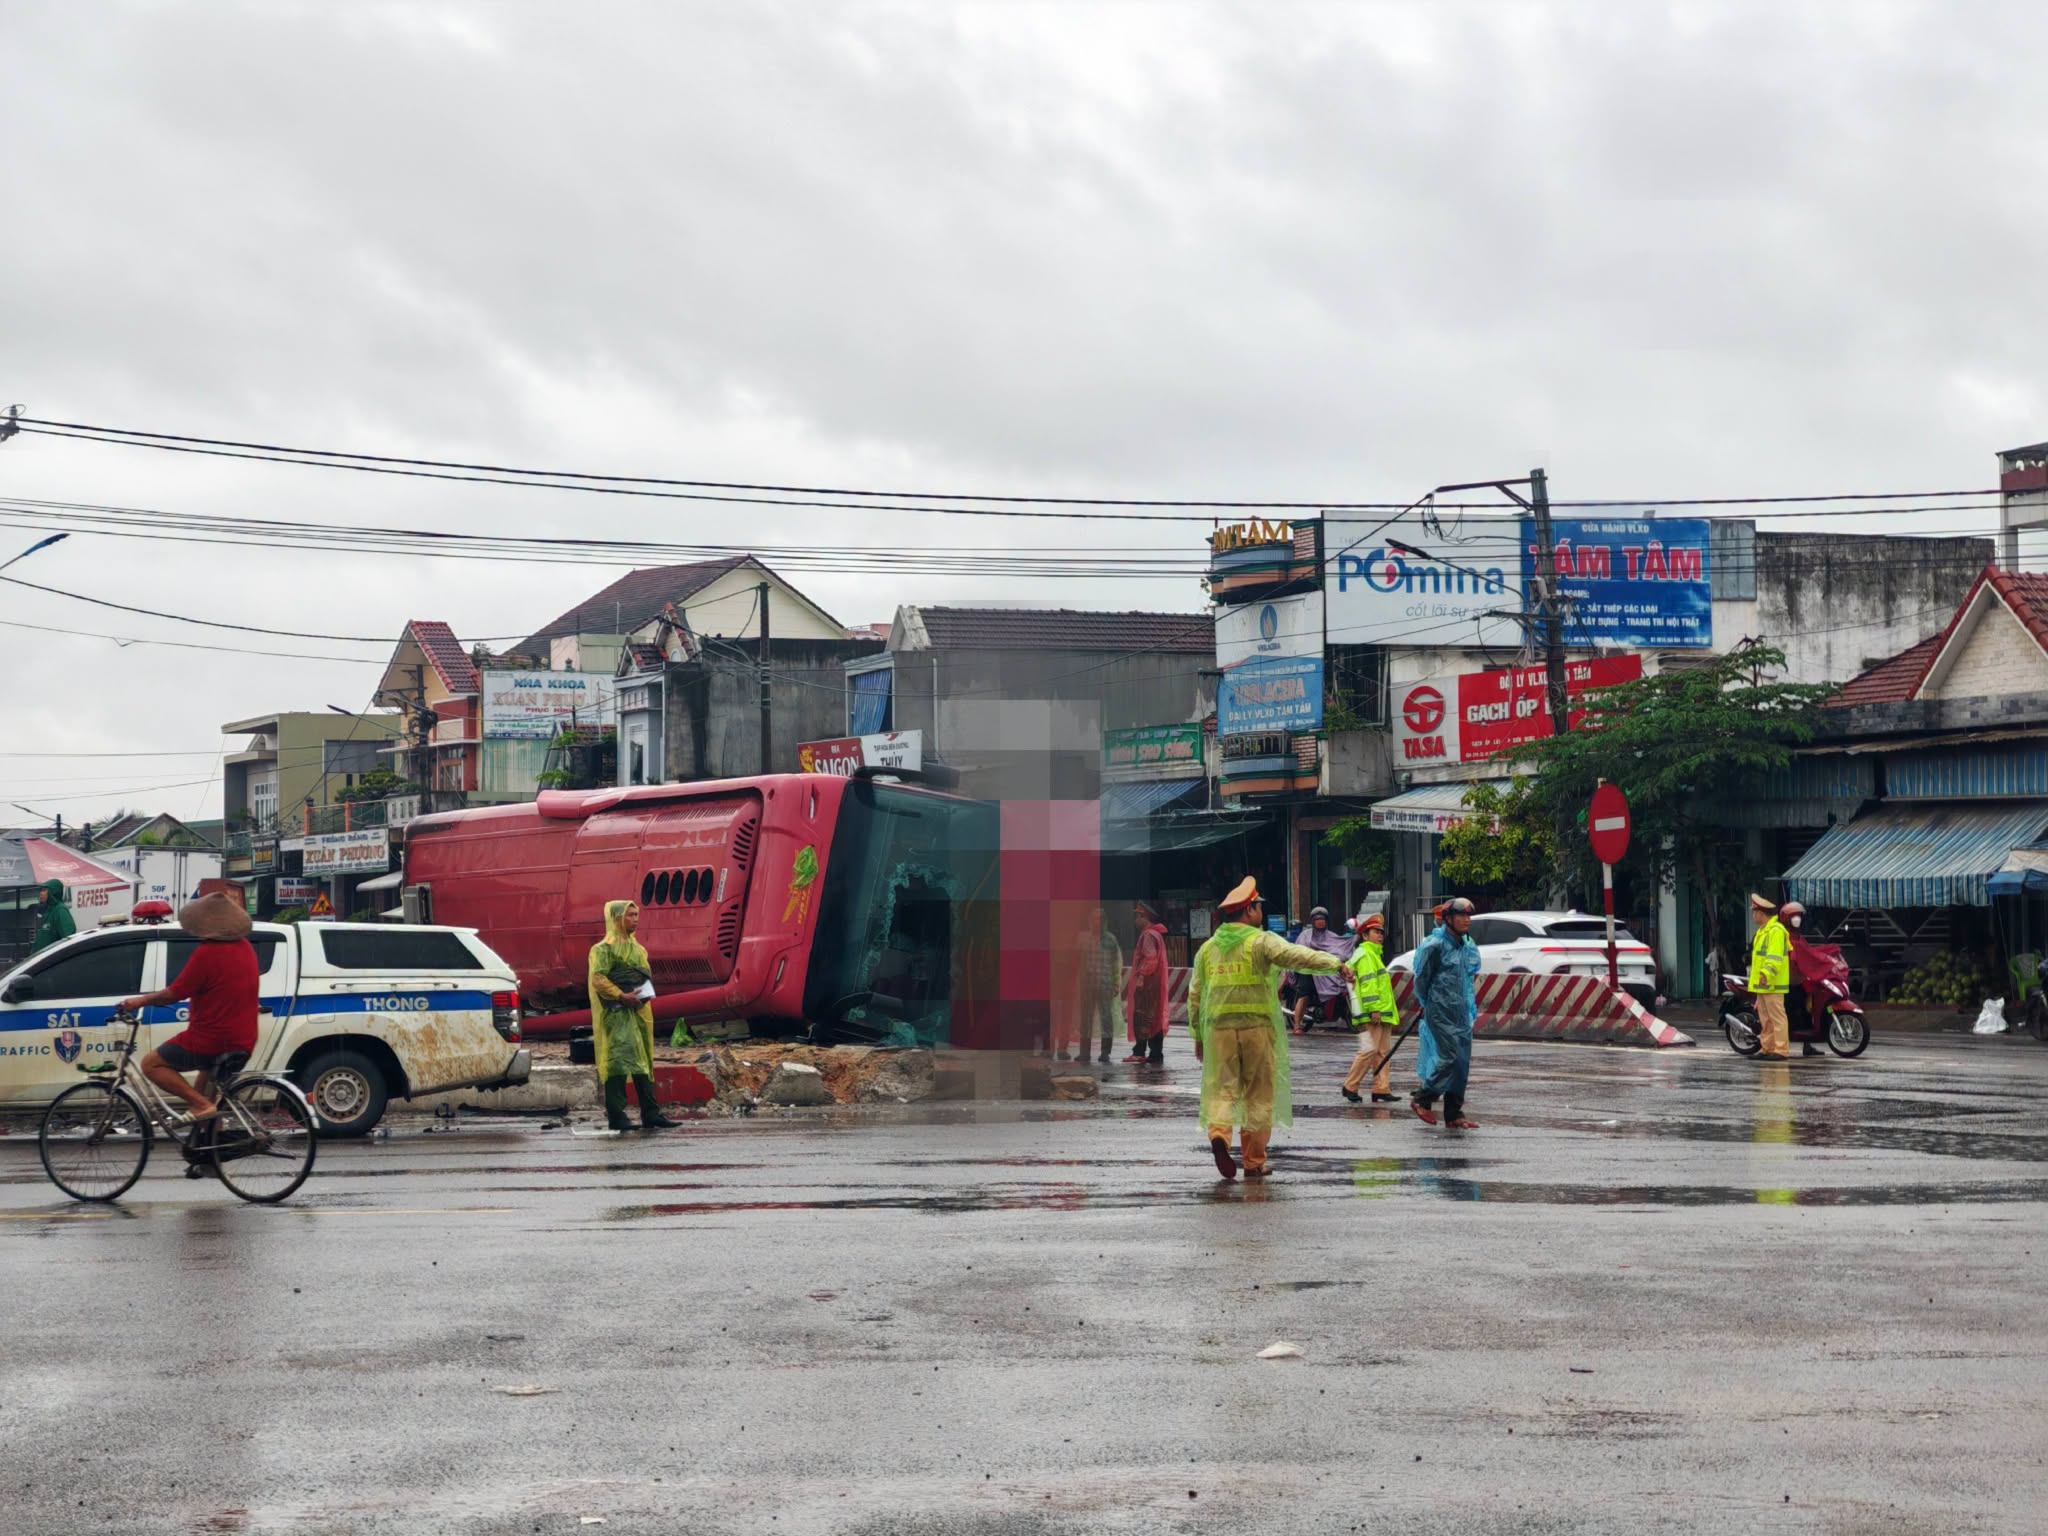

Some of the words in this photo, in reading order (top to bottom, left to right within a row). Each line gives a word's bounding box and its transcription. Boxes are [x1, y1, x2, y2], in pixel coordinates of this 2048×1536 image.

[1622, 540, 1702, 581] TÂM
[548, 679, 586, 689] KHOA
[1515, 692, 1539, 718] ỐP
[1402, 735, 1446, 759] TASA
[77, 887, 109, 908] EXPRESS
[47, 1009, 81, 1028] SÁT
